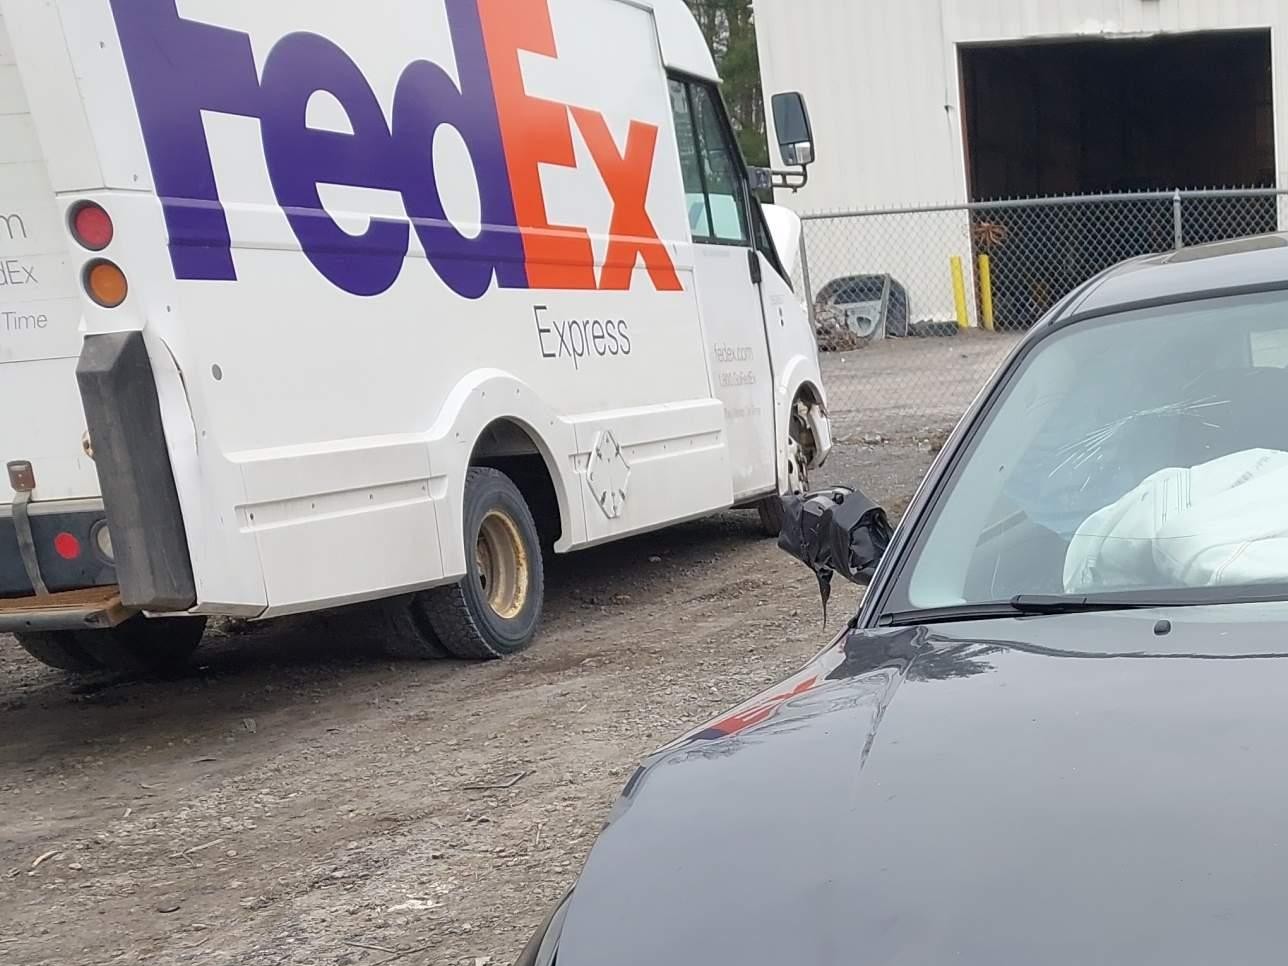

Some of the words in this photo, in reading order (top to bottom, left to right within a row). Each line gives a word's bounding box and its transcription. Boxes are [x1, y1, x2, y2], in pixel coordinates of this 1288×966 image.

[111, 0, 684, 300] FedEx
[2, 311, 48, 330] Time
[533, 305, 631, 370] Express
